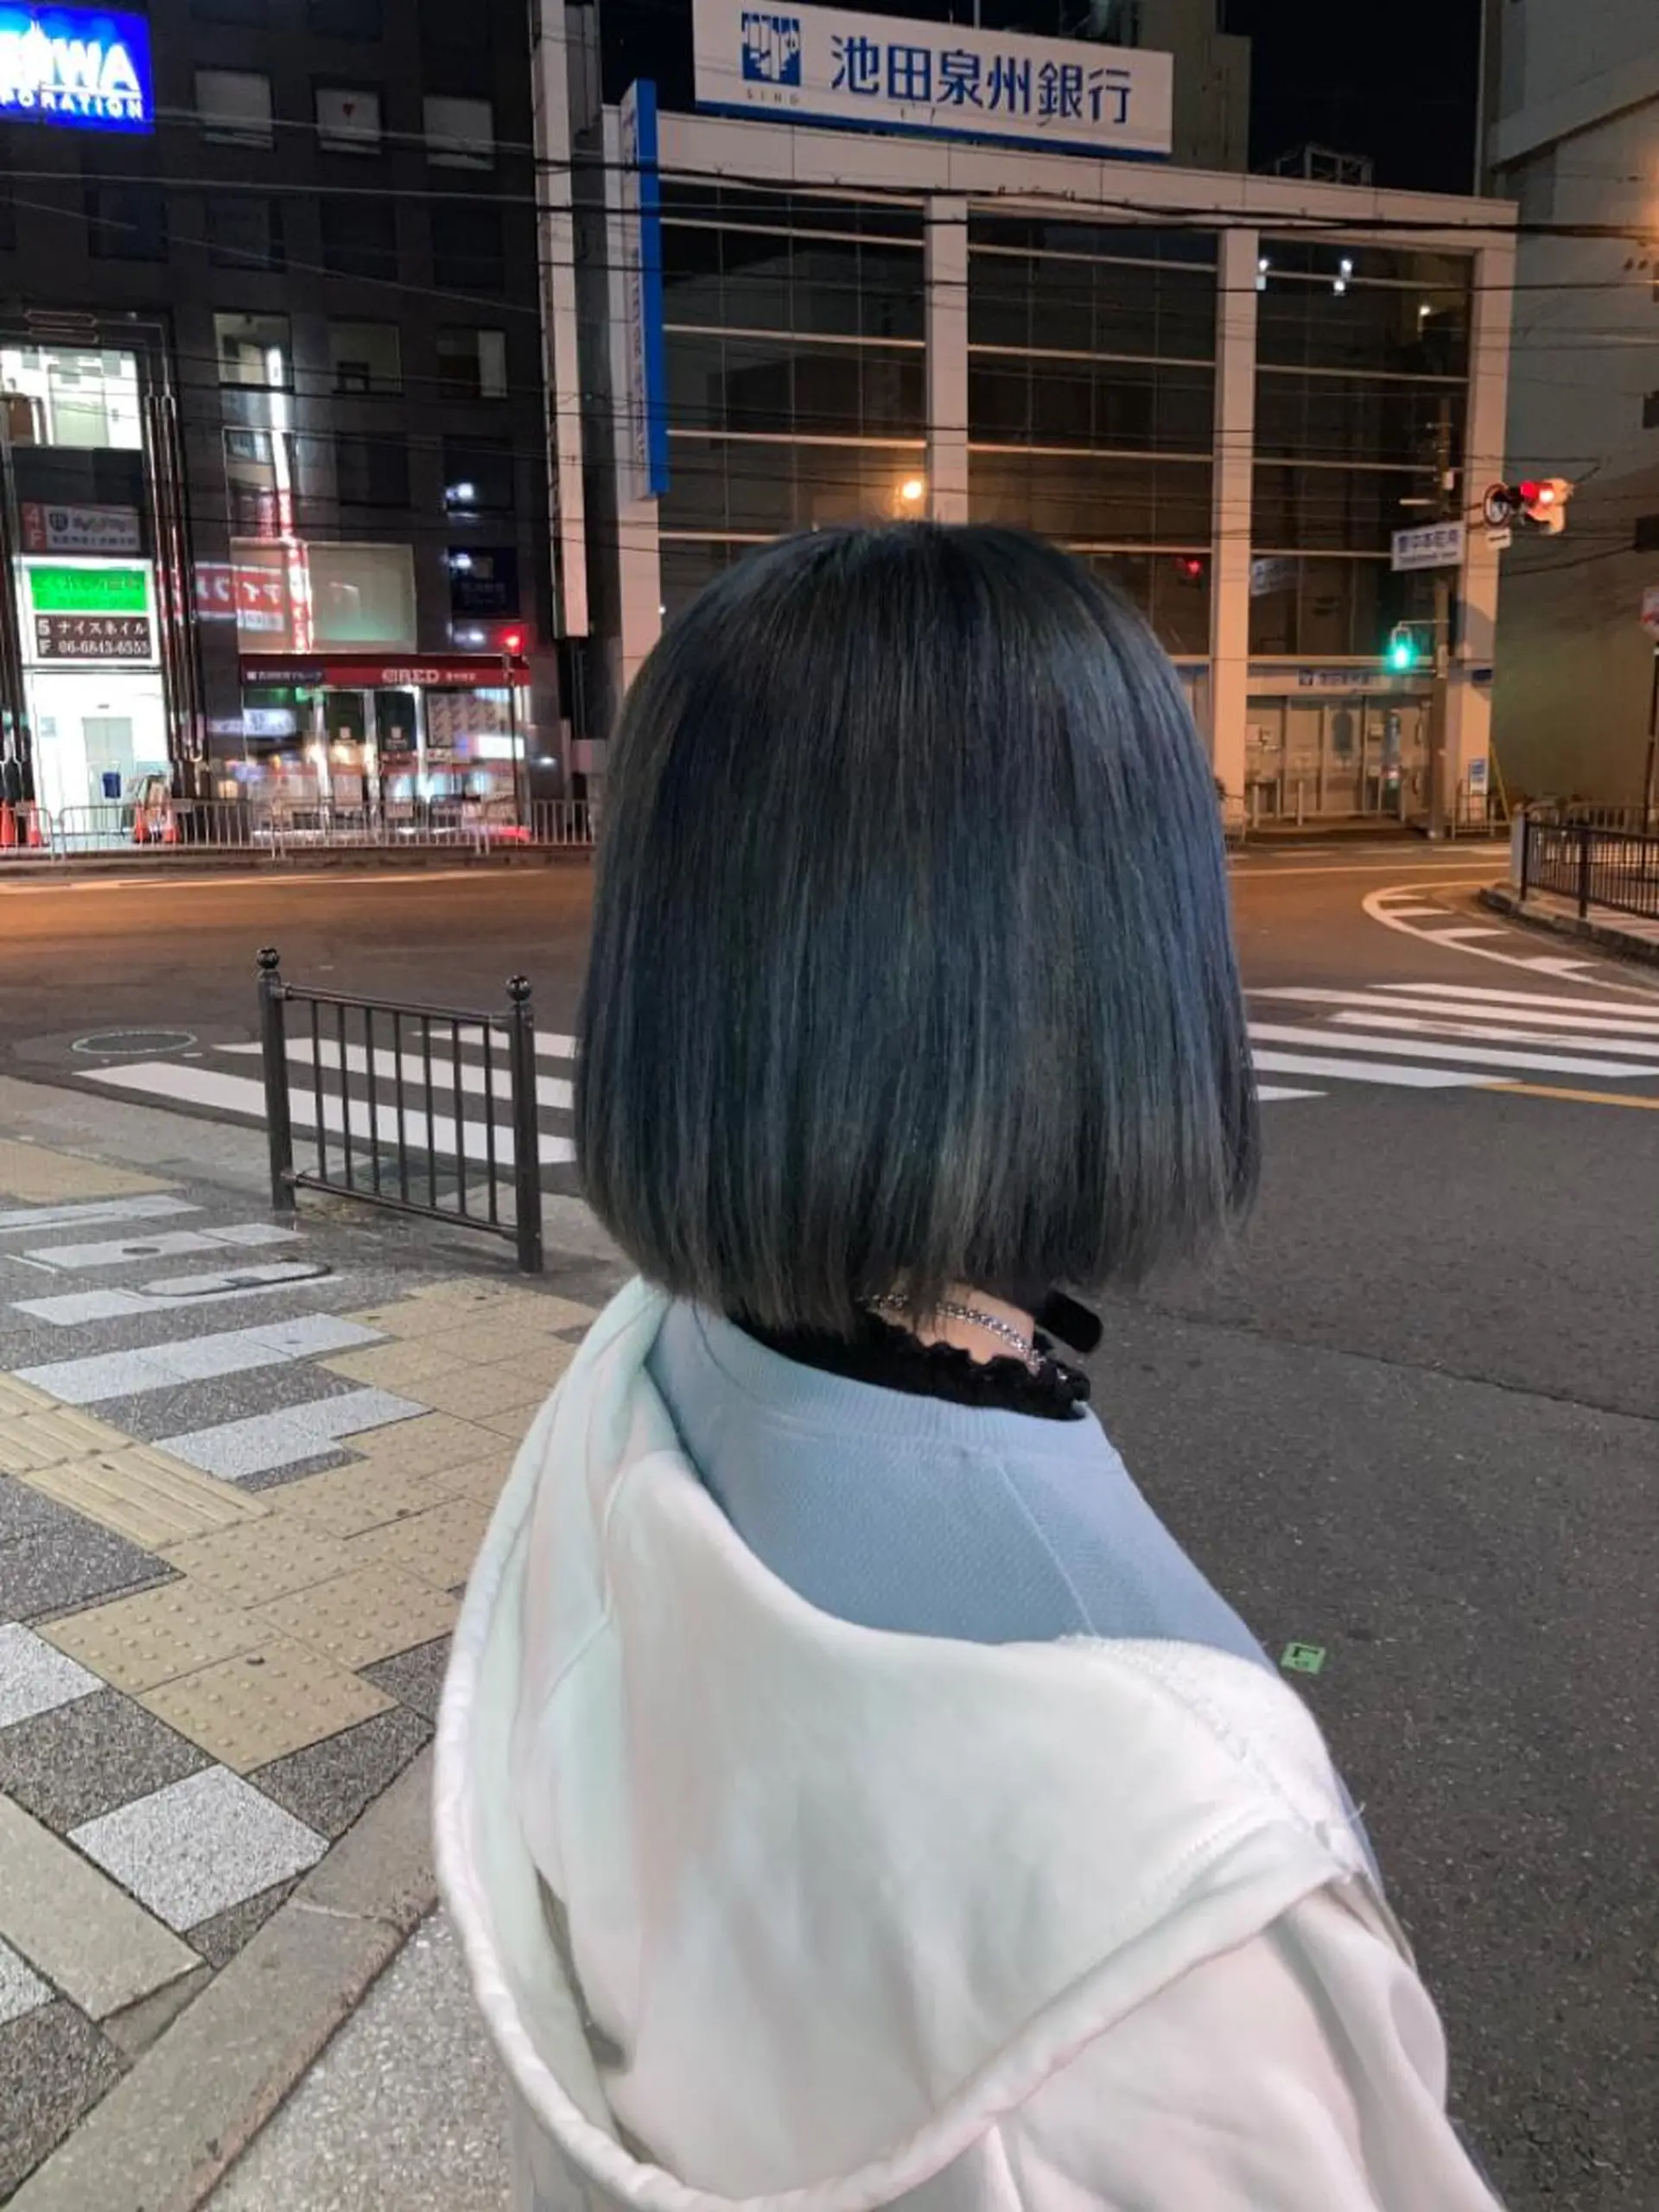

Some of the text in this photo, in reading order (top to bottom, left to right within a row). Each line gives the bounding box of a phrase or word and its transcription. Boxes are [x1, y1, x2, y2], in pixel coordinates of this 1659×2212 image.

[830, 33, 1132, 124] 池田泉州銀行
